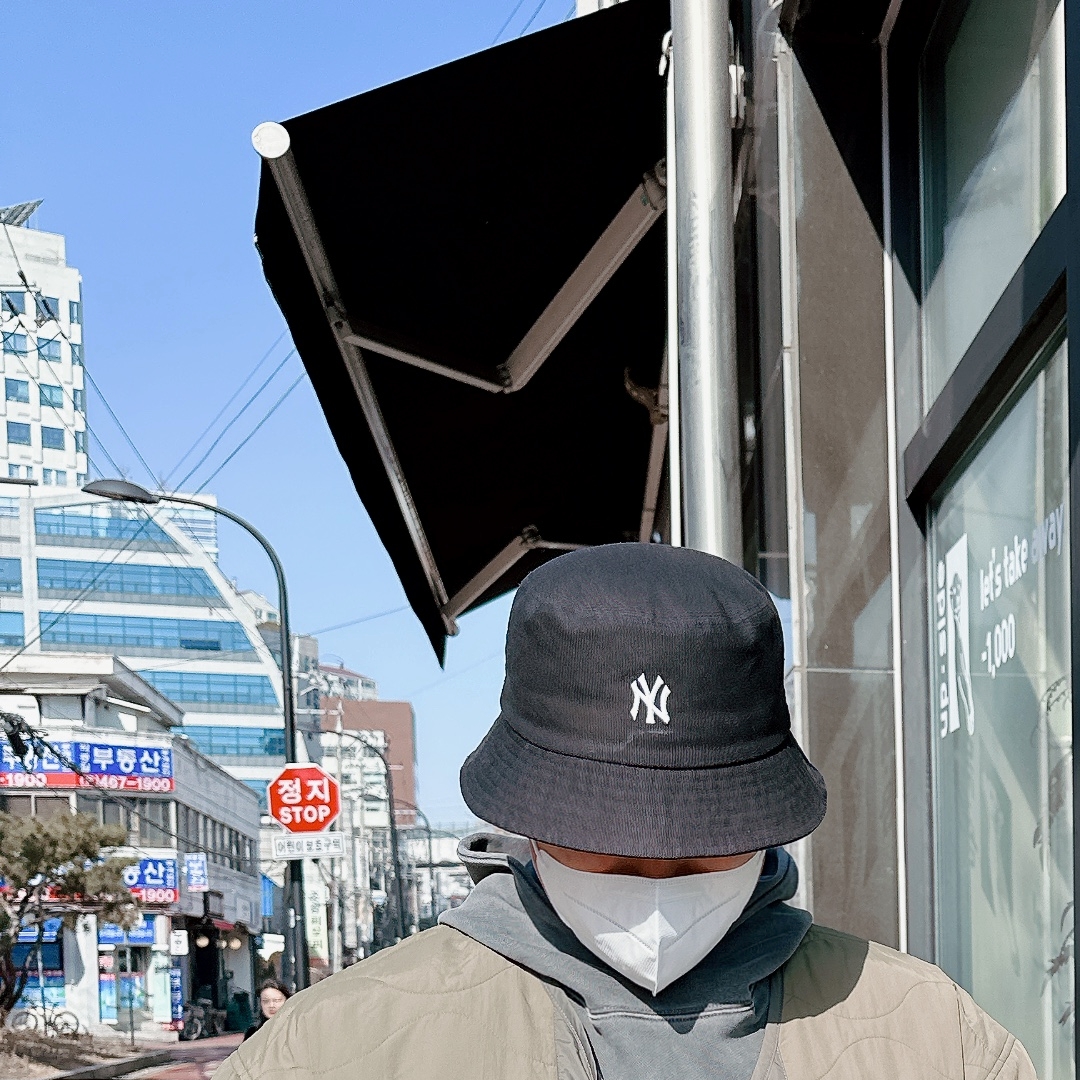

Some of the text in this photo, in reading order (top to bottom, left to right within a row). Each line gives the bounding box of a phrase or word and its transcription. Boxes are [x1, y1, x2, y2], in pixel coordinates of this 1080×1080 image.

[979, 503, 1064, 611] let's take away
[981, 612, 1015, 679] -1,000
[630, 672, 671, 724] NY
[93, 747, 162, 773] 부동산
[278, 776, 331, 805] 정지
[279, 804, 331, 825] STOP
